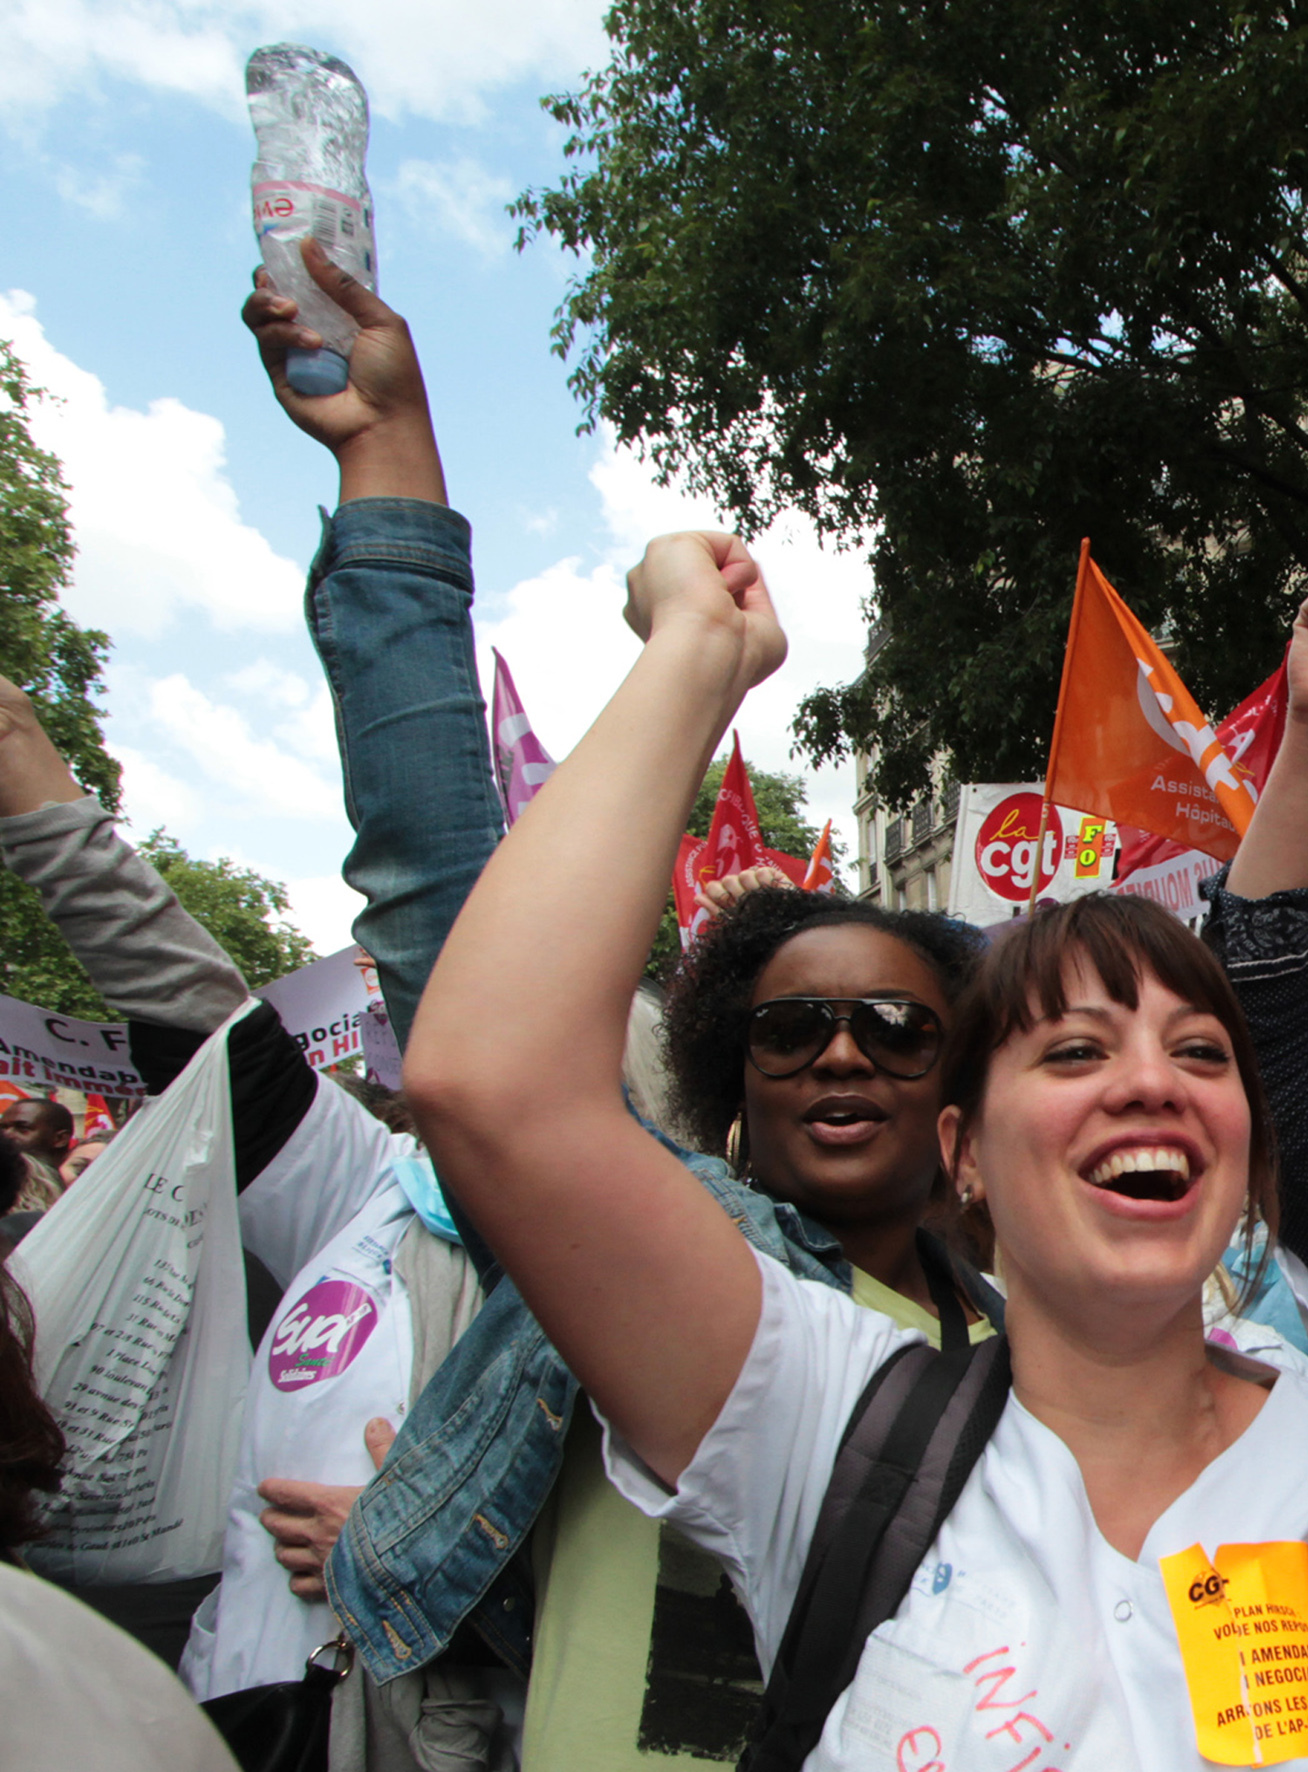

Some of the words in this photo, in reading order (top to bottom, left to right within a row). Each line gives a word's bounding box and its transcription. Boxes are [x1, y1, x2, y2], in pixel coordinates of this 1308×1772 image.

[1151, 775, 1219, 804] Assista
[989, 809, 1043, 841] la
[1176, 802, 1237, 833] Hôpitau
[981, 830, 1057, 888] cgt
[1234, 1604, 1263, 1619] PLAN
[1254, 1620, 1278, 1634] NOS
[1285, 1695, 1307, 1711] LES
[1255, 1722, 1273, 1741] DE
